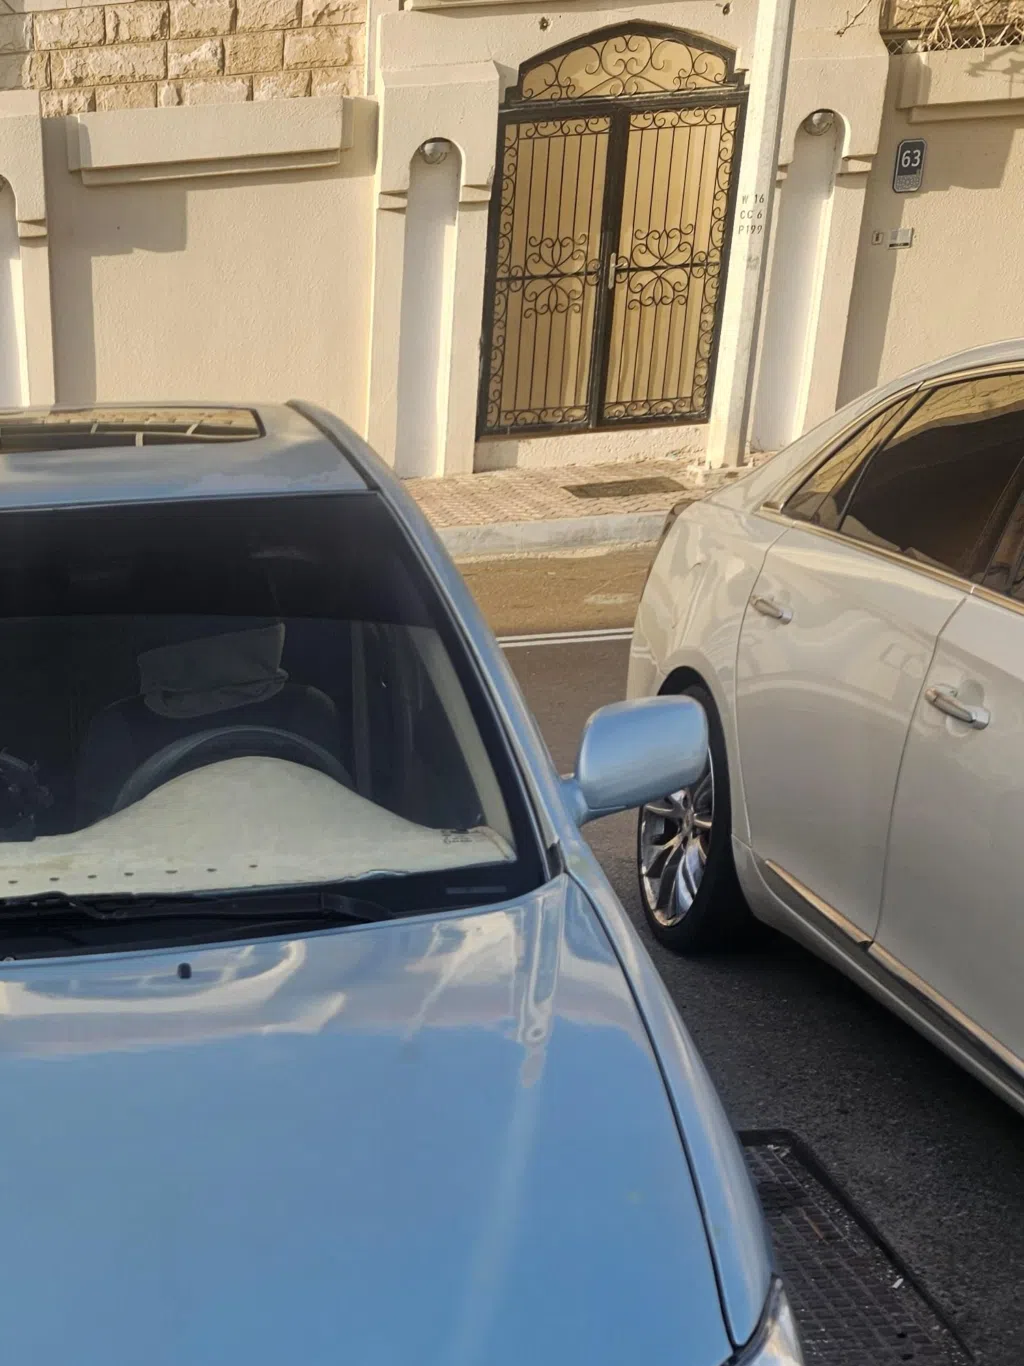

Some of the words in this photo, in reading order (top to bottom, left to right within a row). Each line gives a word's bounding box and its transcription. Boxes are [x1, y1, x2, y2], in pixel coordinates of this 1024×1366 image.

[902, 150, 921, 167] 63
[754, 194, 764, 204] 16
[757, 210, 762, 219] 6
